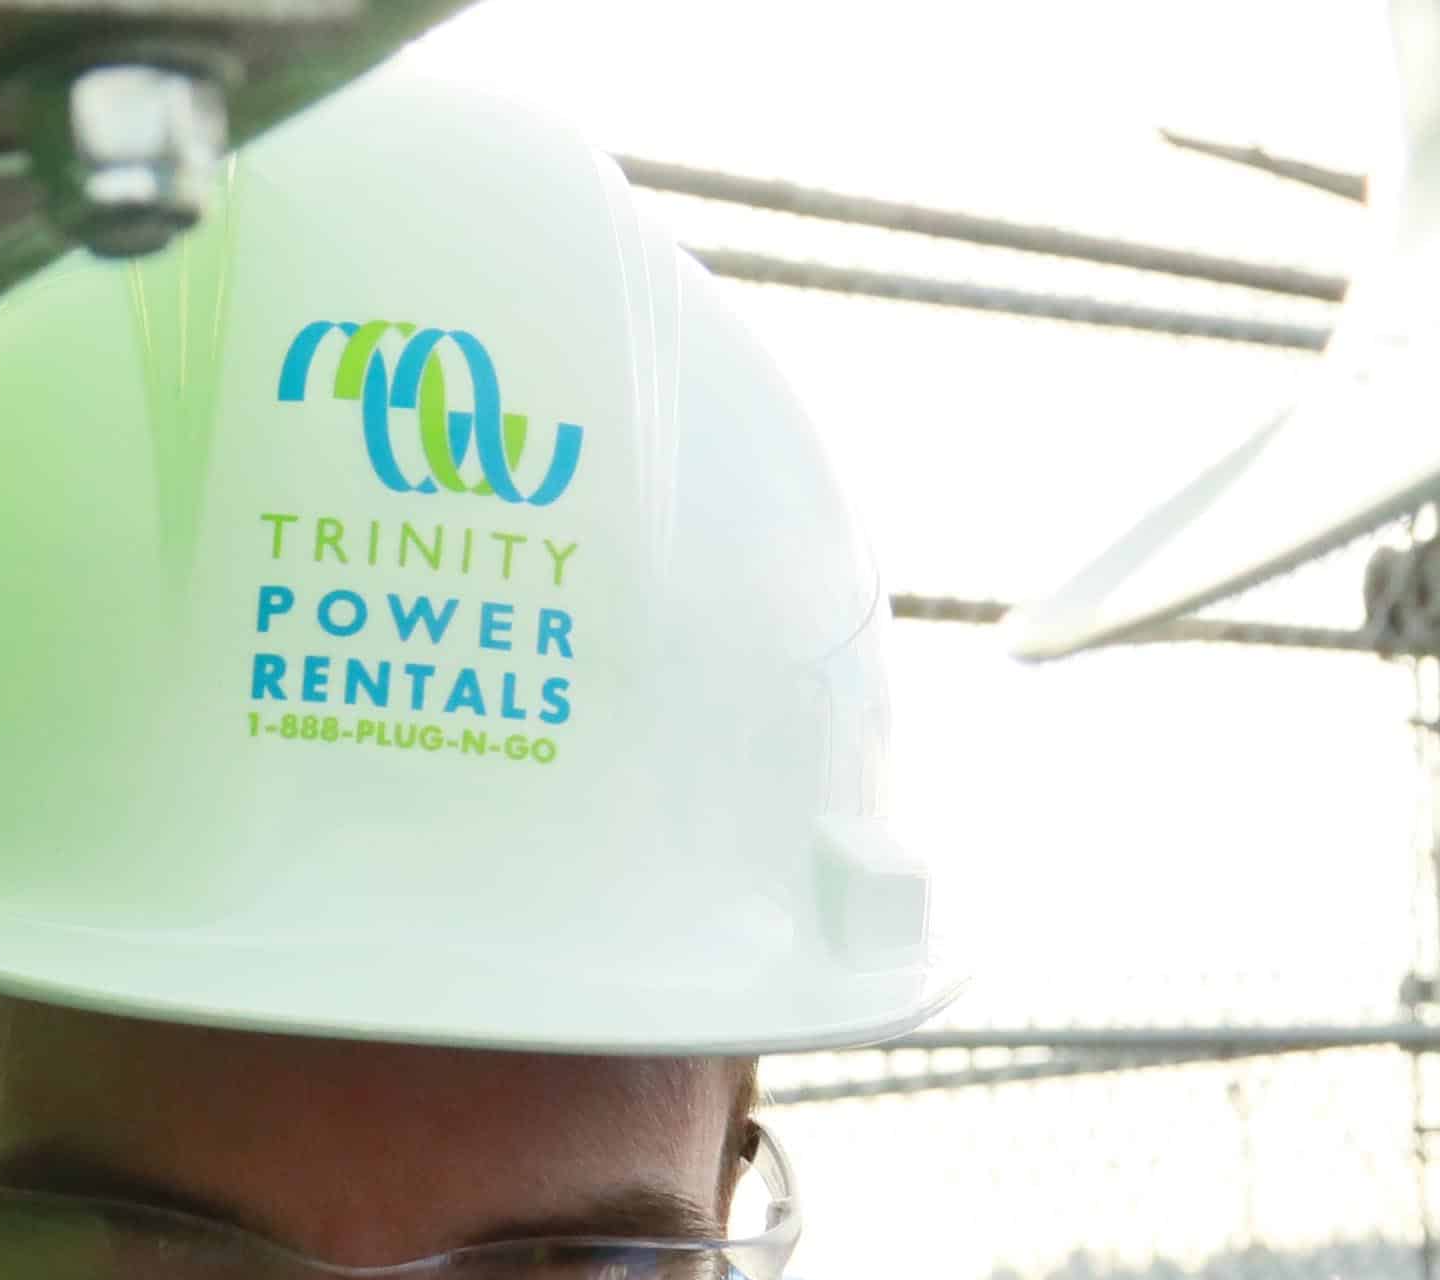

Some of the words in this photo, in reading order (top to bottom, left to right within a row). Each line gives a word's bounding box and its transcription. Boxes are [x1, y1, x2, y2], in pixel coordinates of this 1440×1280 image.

[260, 513, 579, 586] TRINITY
[256, 585, 574, 660] POWER
[250, 652, 572, 725] RENTALS
[247, 711, 558, 765] 1-888-PLUG-N-GO
